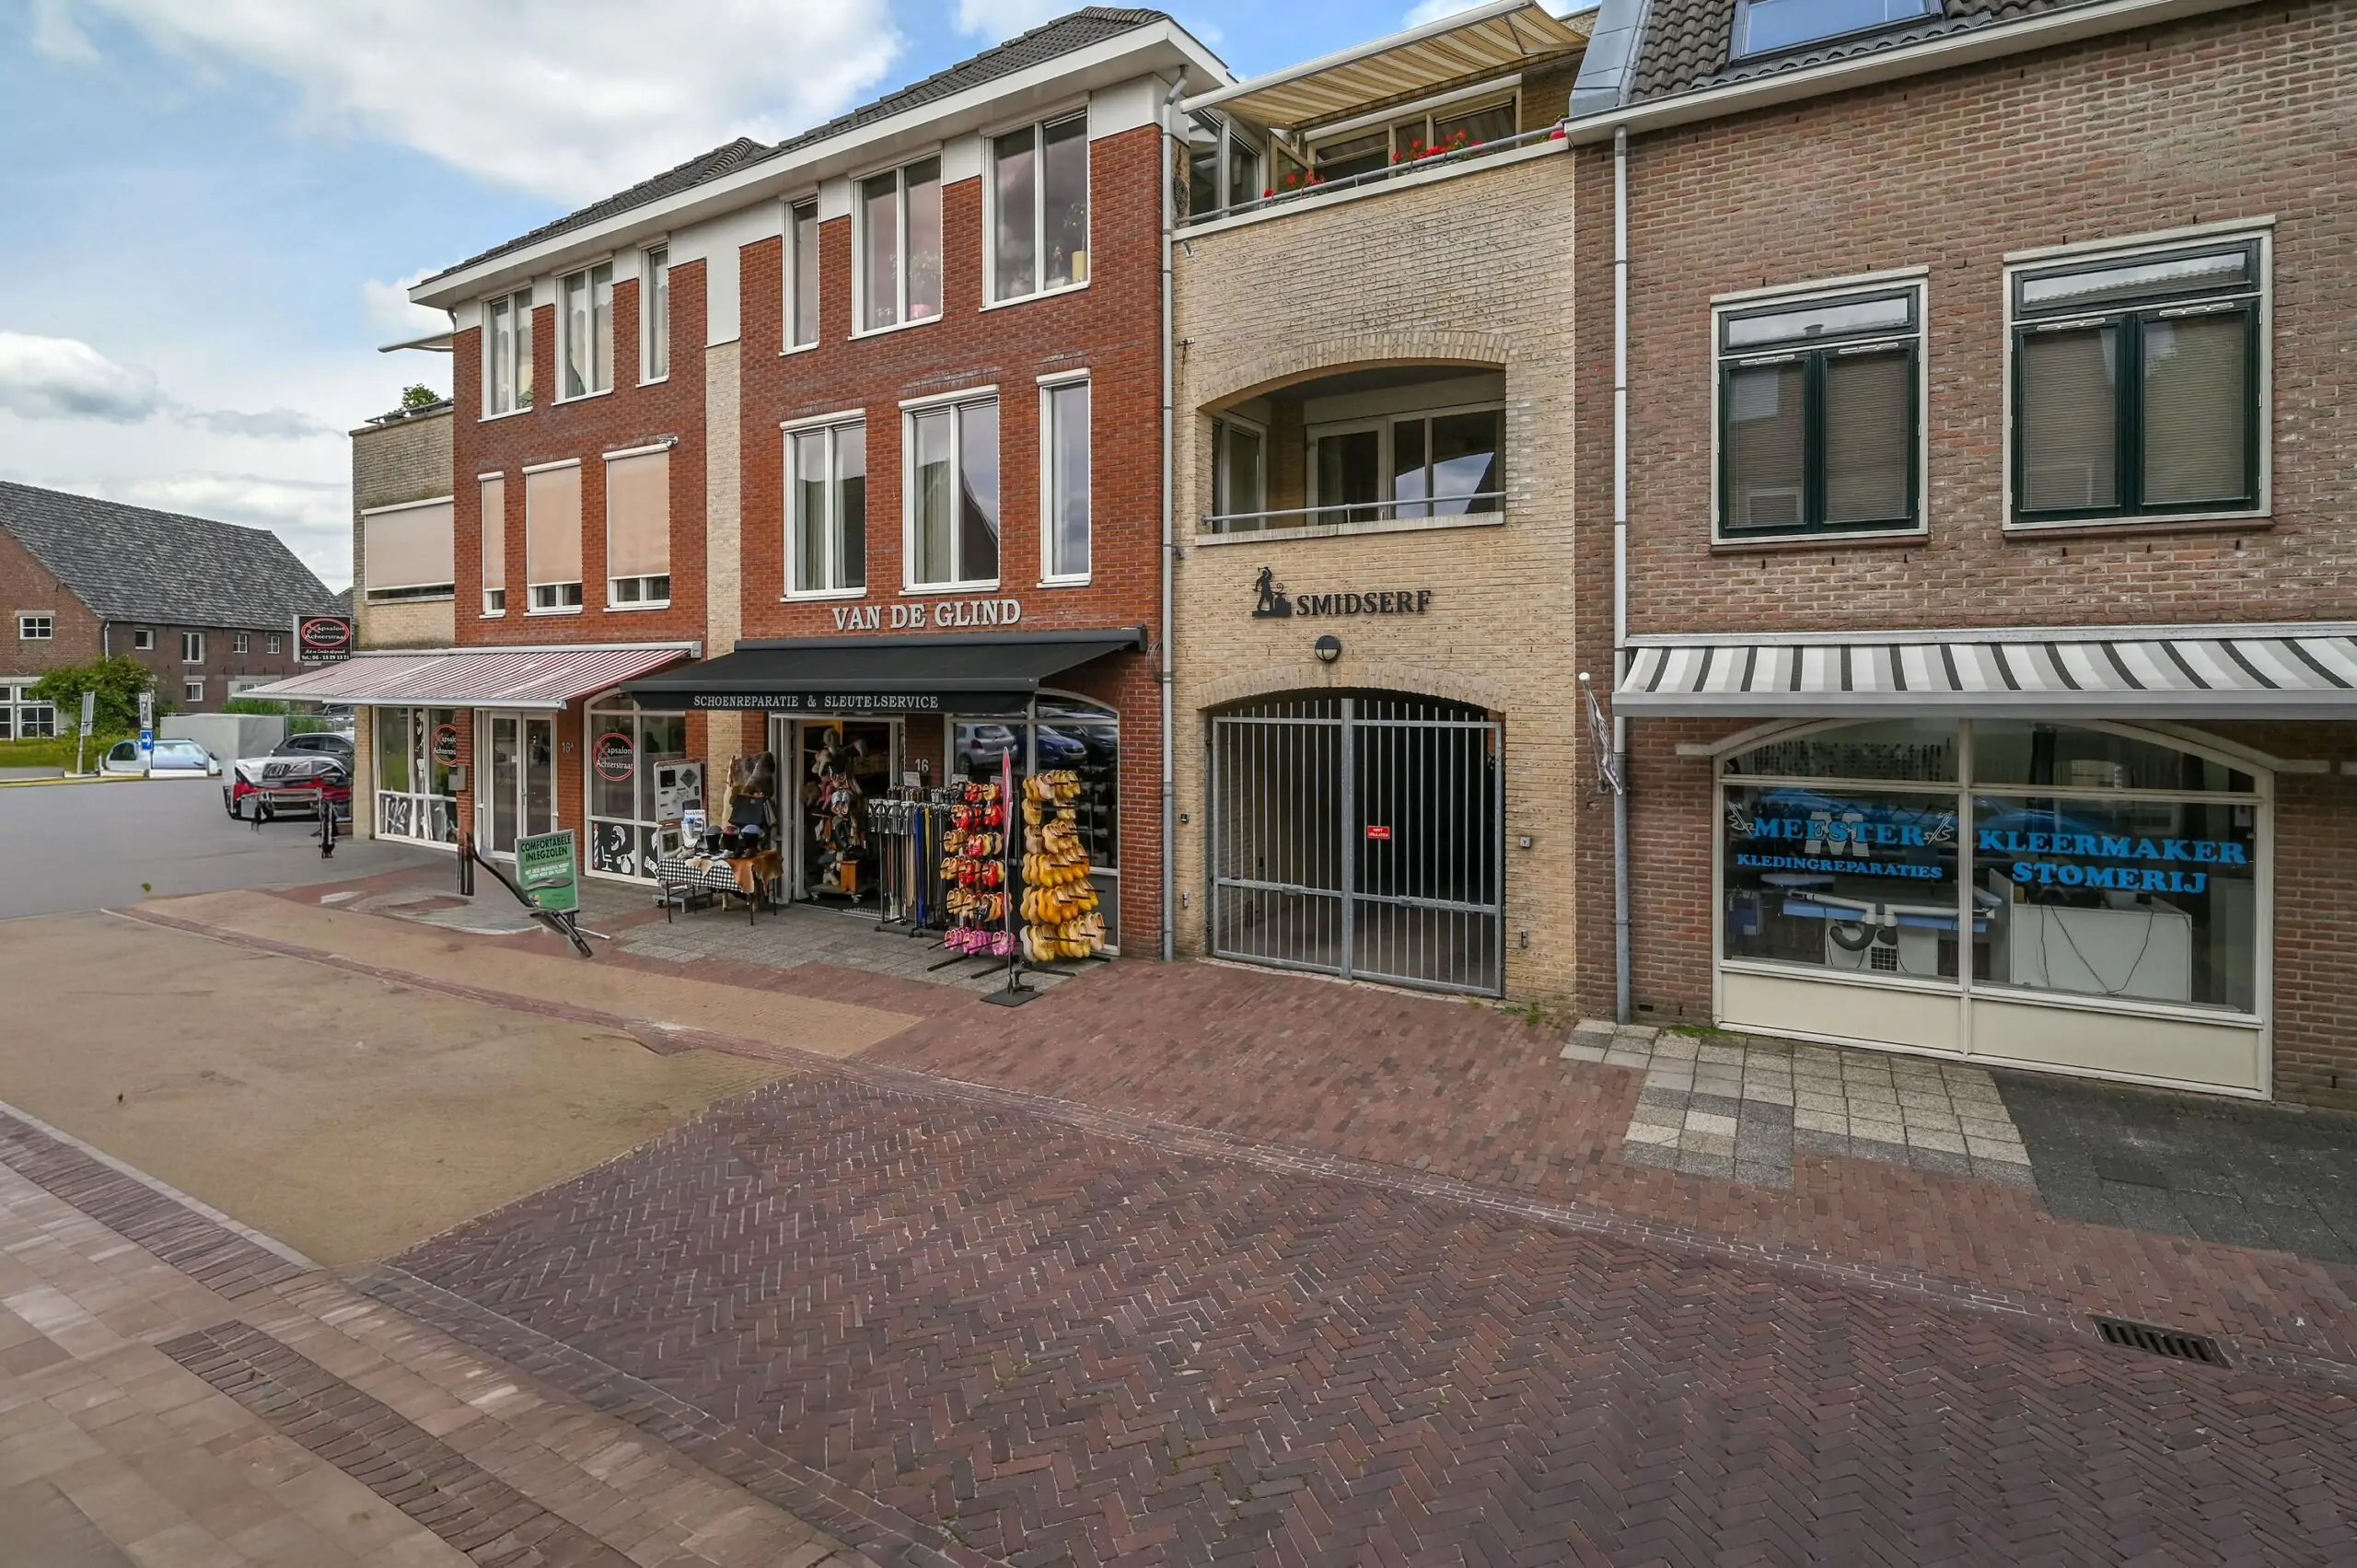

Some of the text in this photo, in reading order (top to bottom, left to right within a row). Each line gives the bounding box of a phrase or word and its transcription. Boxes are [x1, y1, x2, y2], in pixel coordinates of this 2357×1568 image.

[832, 599, 1021, 631] VAN DE GLIND
[1296, 590, 1432, 616] SMIDSERF
[693, 695, 938, 709] SCHOENREPARATIE & SLEUTELSERVICE
[597, 759, 633, 770] Achterstraat
[915, 758, 929, 772] 16
[520, 834, 572, 853] COMFORTABELE
[1753, 817, 1925, 847] MEESTER
[526, 846, 568, 863] INLEGZOLEN
[1979, 830, 2247, 865] KLEERMAKER
[1736, 854, 1943, 878] KLEDINGREPARATIES
[2012, 862, 2207, 894] STOMERIJ
